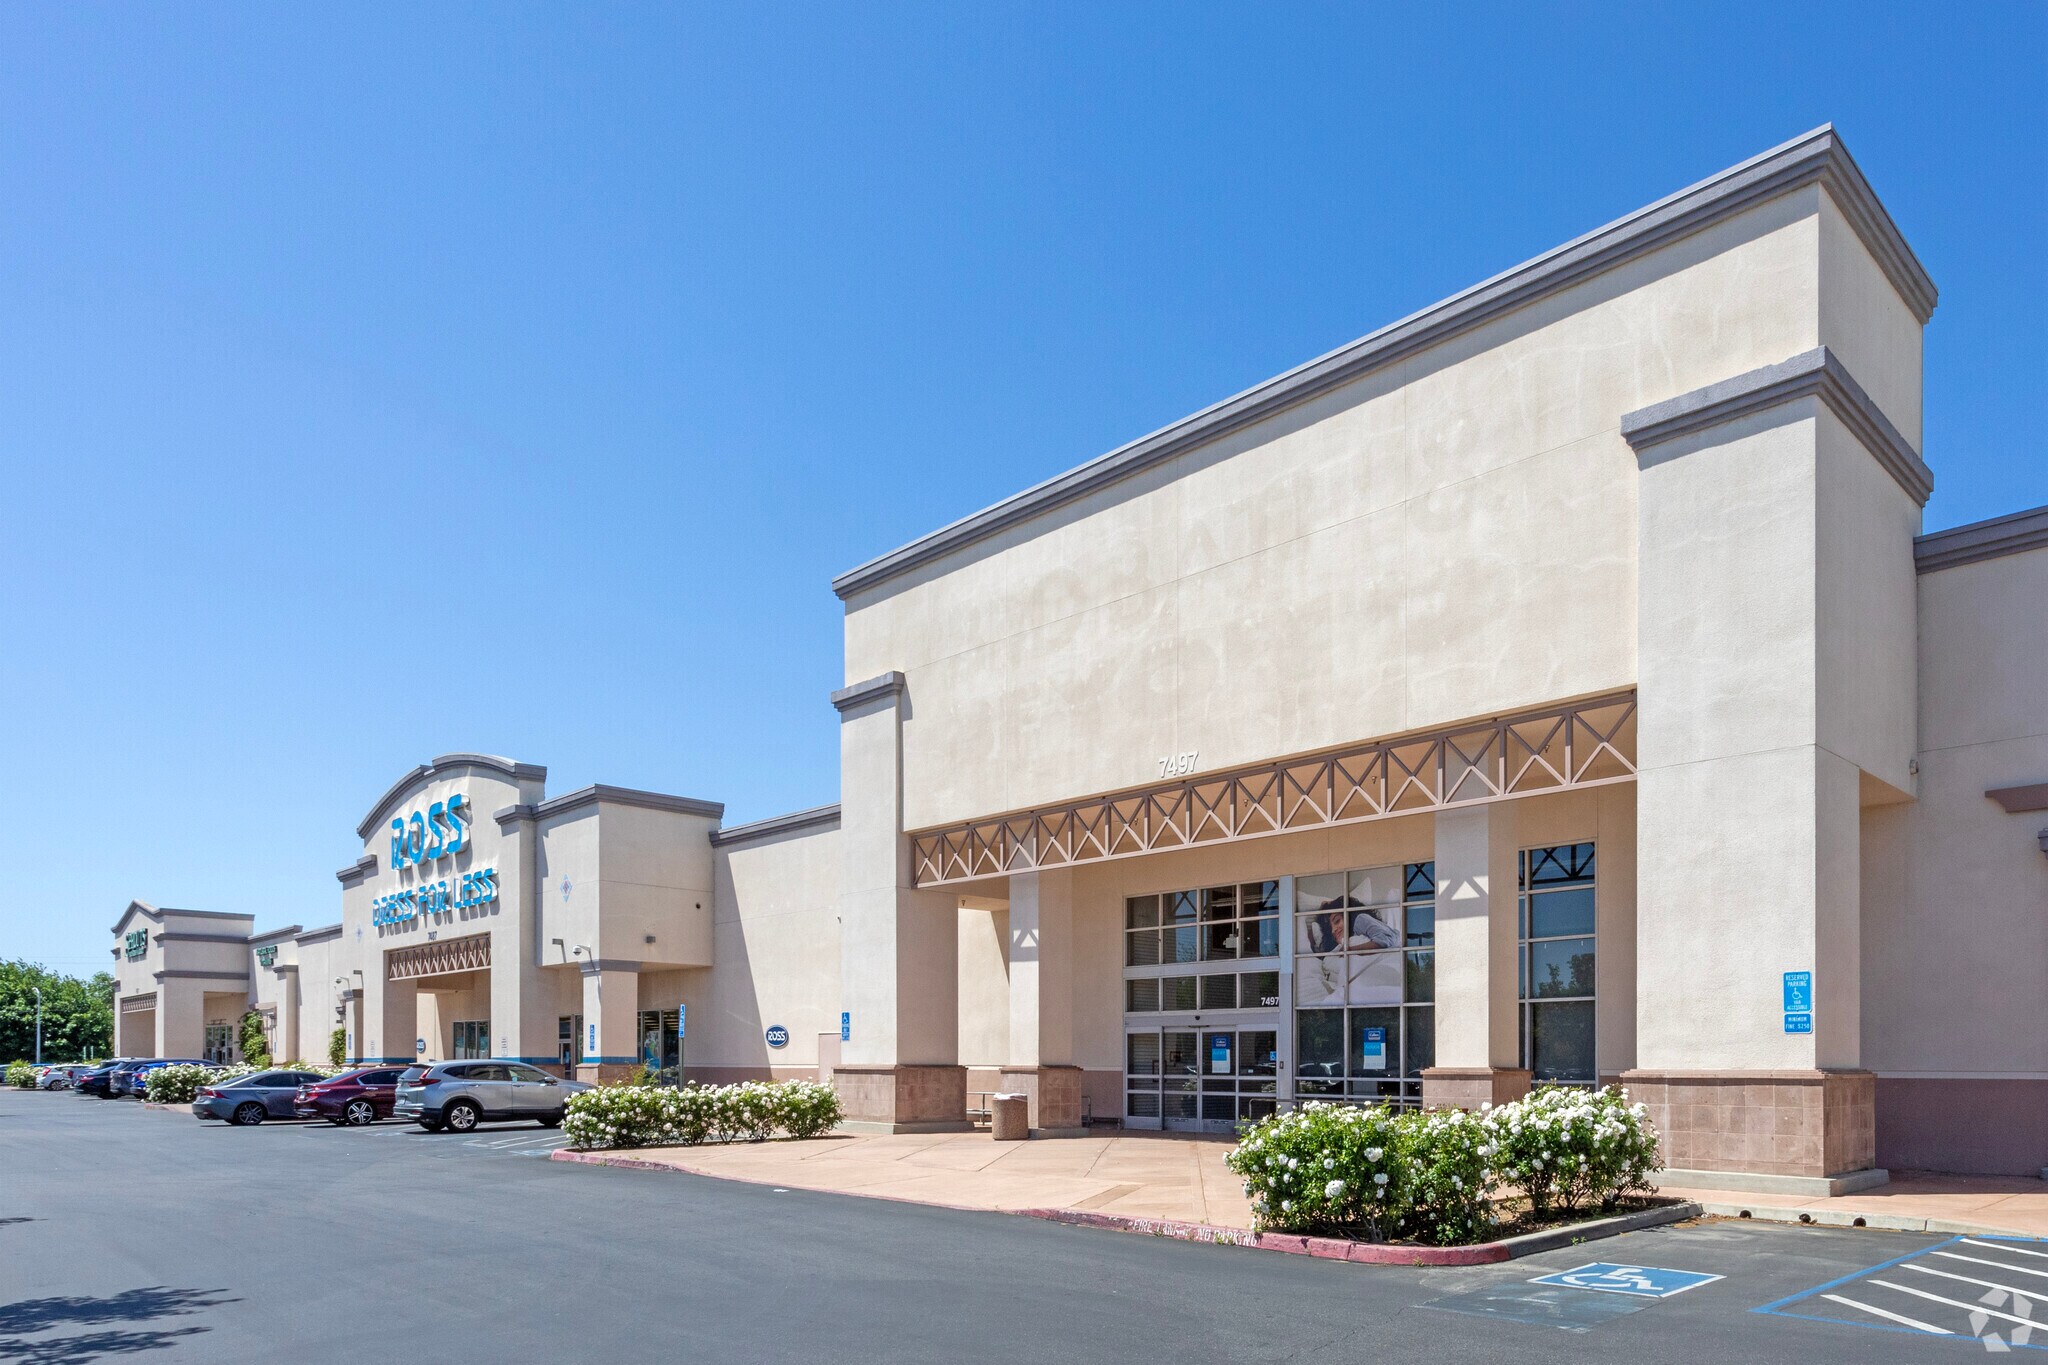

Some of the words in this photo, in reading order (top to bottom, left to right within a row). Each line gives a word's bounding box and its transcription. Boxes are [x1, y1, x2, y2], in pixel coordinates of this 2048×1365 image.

[1159, 751, 1199, 778] 7497
[391, 793, 468, 870] ROSS
[372, 889, 416, 927] DRESS
[418, 880, 450, 916] FOR
[454, 867, 497, 909] LESS
[1261, 996, 1279, 1006] 7497
[767, 1031, 786, 1042] ROSS
[1133, 1219, 1152, 1233] FIRE
[1196, 1228, 1211, 1241] NO
[1213, 1229, 1257, 1247] PARKING
